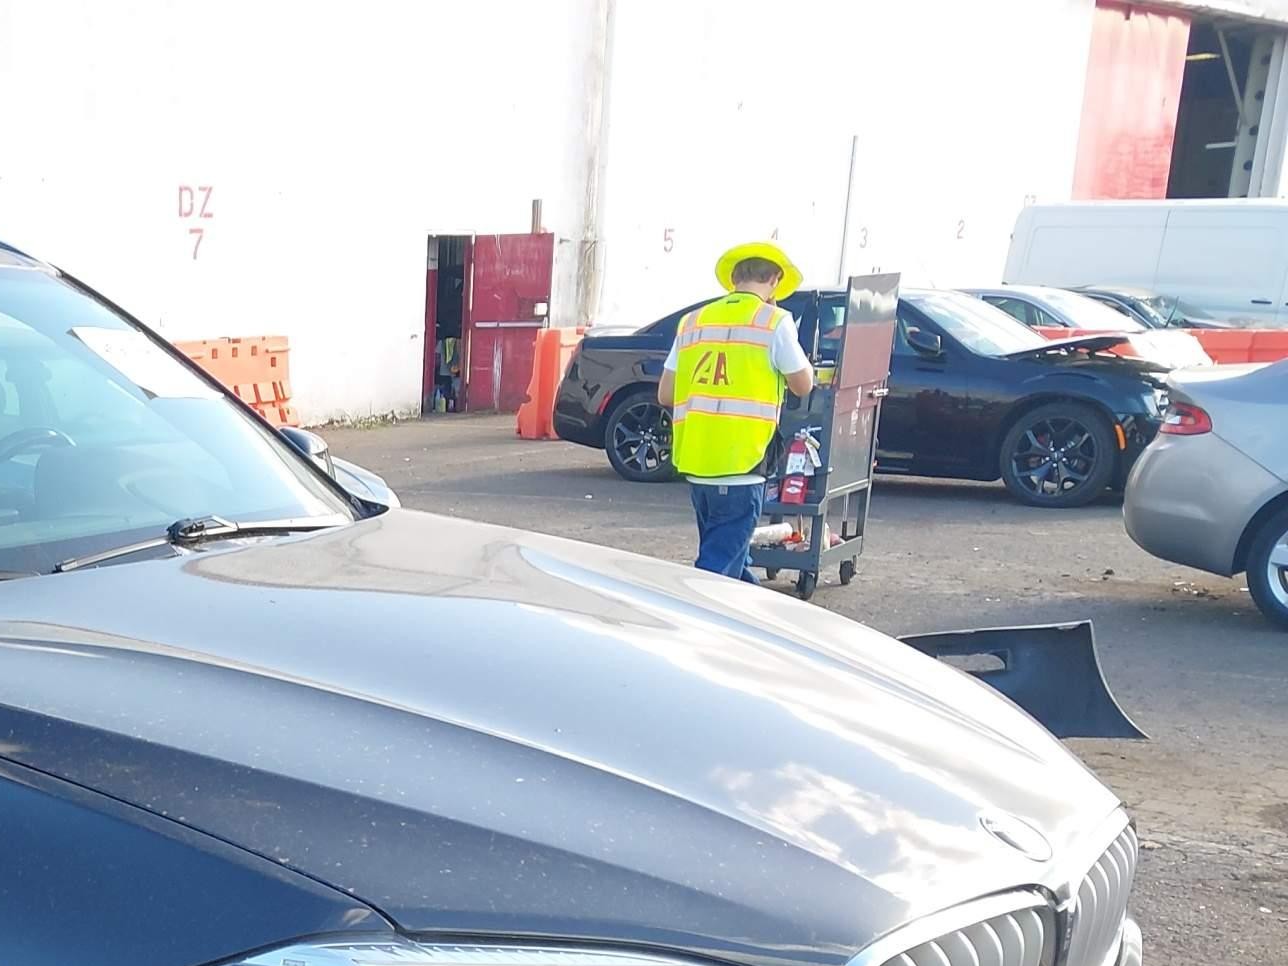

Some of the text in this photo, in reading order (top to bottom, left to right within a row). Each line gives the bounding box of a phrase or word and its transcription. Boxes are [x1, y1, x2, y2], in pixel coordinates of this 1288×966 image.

[178, 186, 214, 218] DZ
[663, 227, 675, 253] 5
[859, 226, 868, 249] 3
[957, 219, 965, 240] 2
[189, 228, 203, 260] 7
